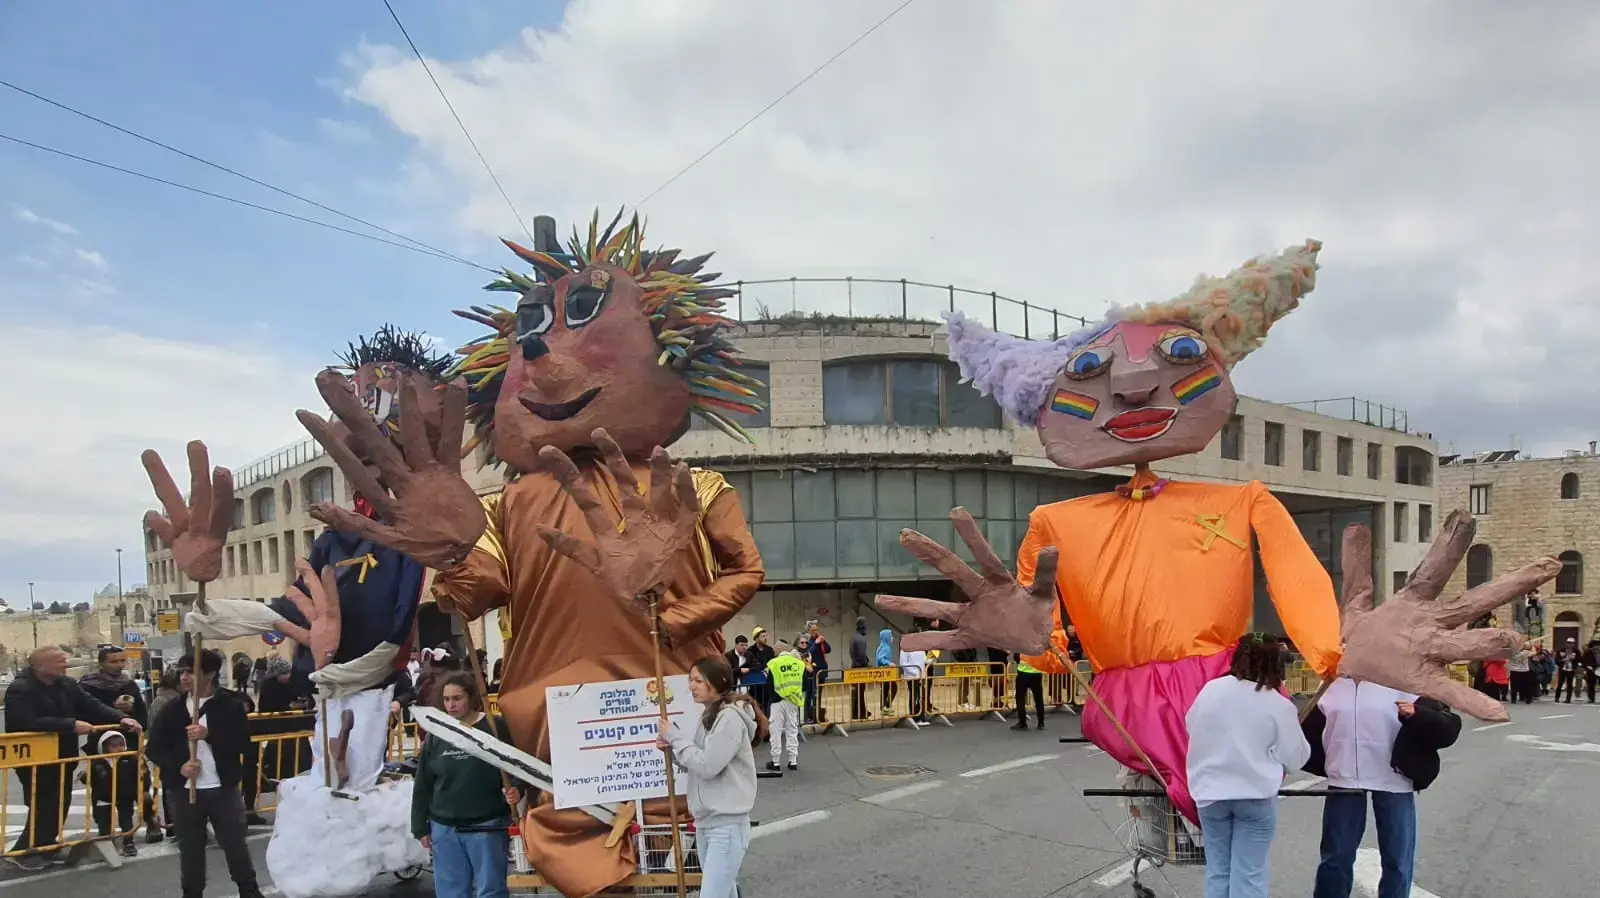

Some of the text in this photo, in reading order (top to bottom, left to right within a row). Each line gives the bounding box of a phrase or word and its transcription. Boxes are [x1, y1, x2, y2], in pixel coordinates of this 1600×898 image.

[600, 688, 636, 699] תהלוכת
[605, 698, 631, 707] פורים
[599, 704, 639, 716] מאוחדים
[584, 726, 625, 741] קטנים
[12, 743, 31, 759] חי
[639, 749, 653, 759] ירון
[601, 773, 628, 783] התיכון
[629, 770, 642, 779] של
[563, 776, 600, 787] הישראלי
